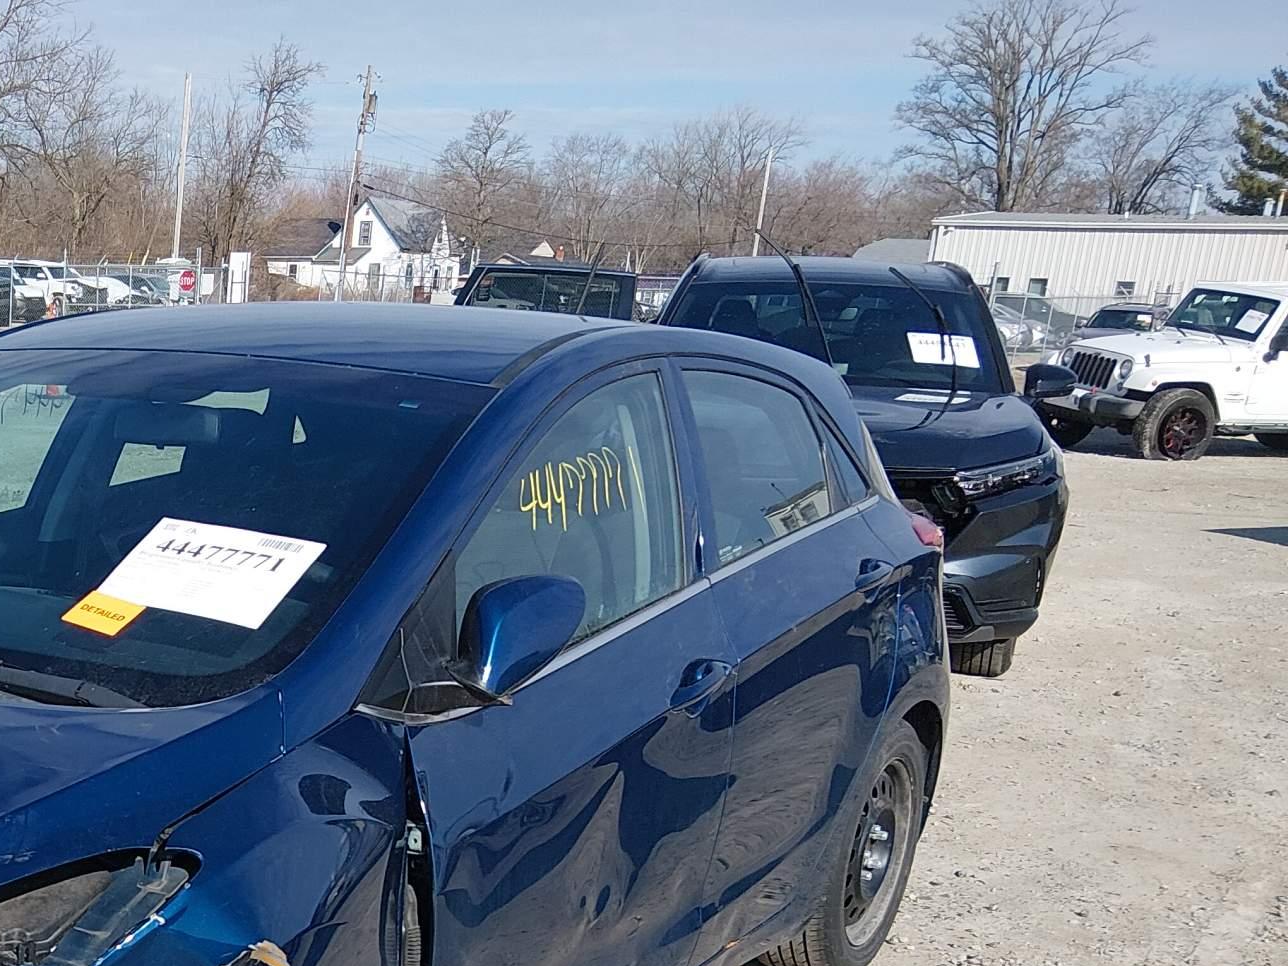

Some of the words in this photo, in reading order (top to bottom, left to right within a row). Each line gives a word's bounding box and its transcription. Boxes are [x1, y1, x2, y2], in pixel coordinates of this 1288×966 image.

[180, 276, 194, 285] STOP
[156, 539, 285, 573] 44477771
[80, 603, 126, 622] DETAILED
